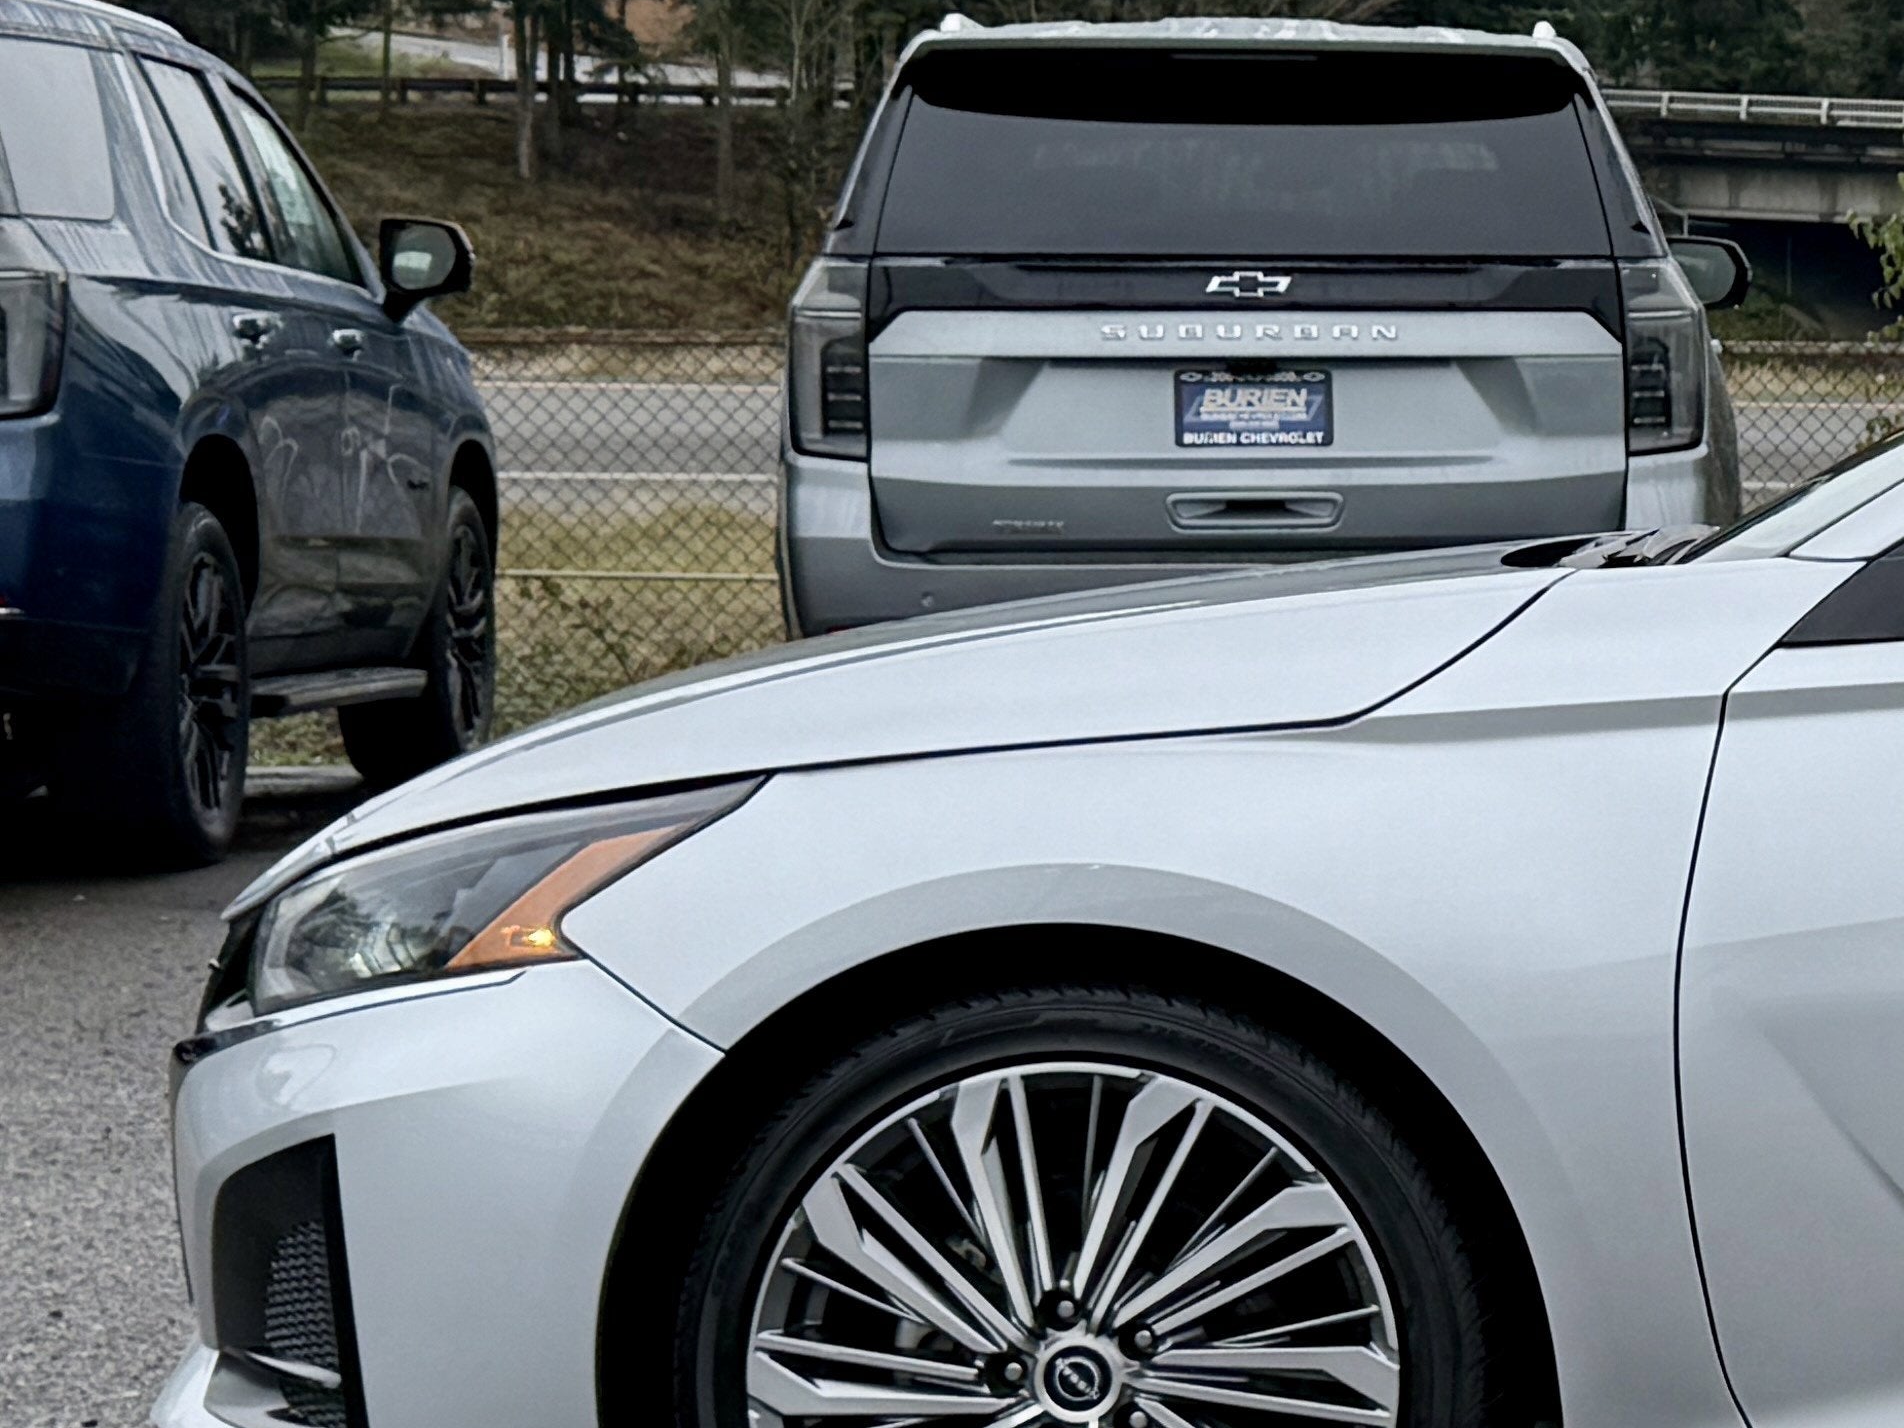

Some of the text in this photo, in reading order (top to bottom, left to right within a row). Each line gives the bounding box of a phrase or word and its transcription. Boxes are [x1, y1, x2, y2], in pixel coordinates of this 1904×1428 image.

[1101, 324, 1398, 340] SUBURBAN
[1203, 387, 1308, 407] BURIEN
[1240, 432, 1325, 445] CHEVROLET
